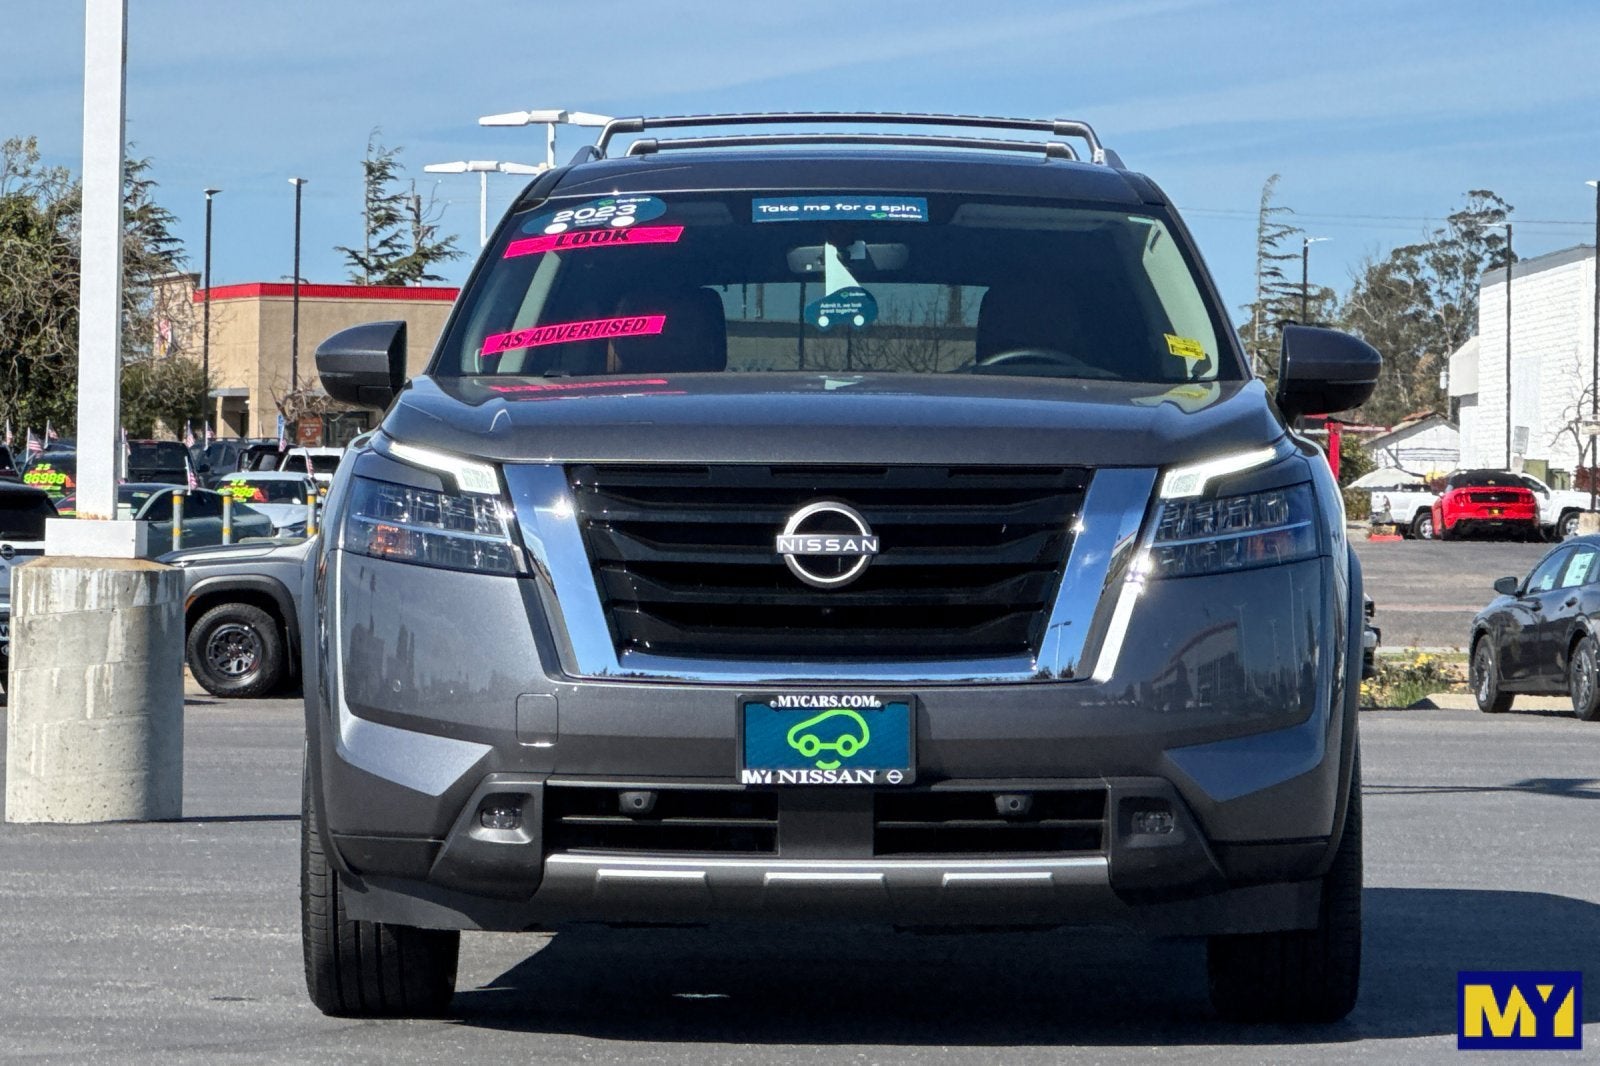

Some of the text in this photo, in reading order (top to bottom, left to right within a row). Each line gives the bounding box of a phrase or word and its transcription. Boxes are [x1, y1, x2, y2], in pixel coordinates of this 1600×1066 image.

[553, 204, 638, 223] 2023
[758, 205, 799, 213] Take
[835, 203, 861, 211] for
[881, 203, 921, 213] spin.
[555, 229, 632, 247] LOOK
[499, 318, 648, 349] AS ADVERTISED
[779, 539, 877, 552] NISSAN
[777, 695, 876, 708] MYCARS.COM
[742, 770, 876, 784] MY NISSAN
